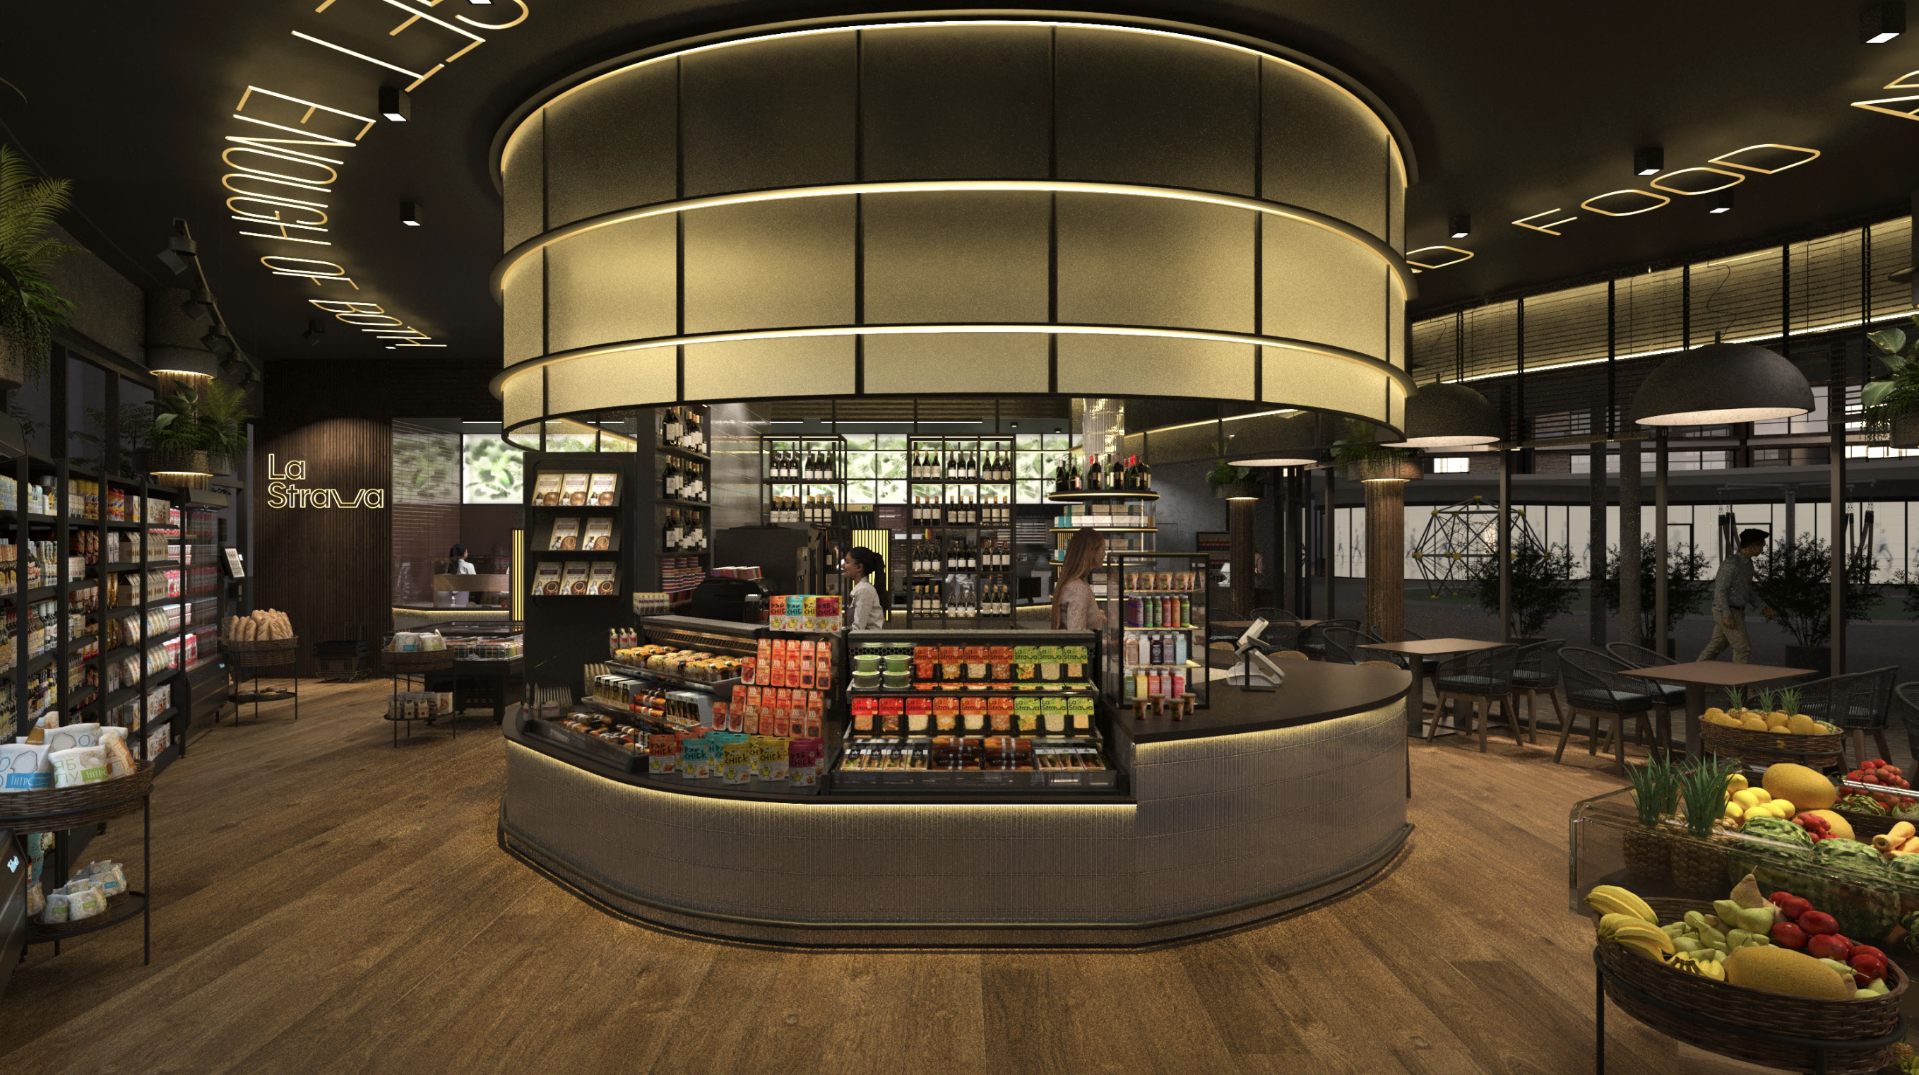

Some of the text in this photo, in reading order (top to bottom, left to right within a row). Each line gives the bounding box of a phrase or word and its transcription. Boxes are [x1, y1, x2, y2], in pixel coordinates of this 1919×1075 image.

[222, 86, 376, 245] ENOUGH
[1511, 143, 1821, 236] FOOD
[261, 255, 359, 290] OF
[309, 299, 447, 347] BOTH
[268, 453, 306, 481] La
